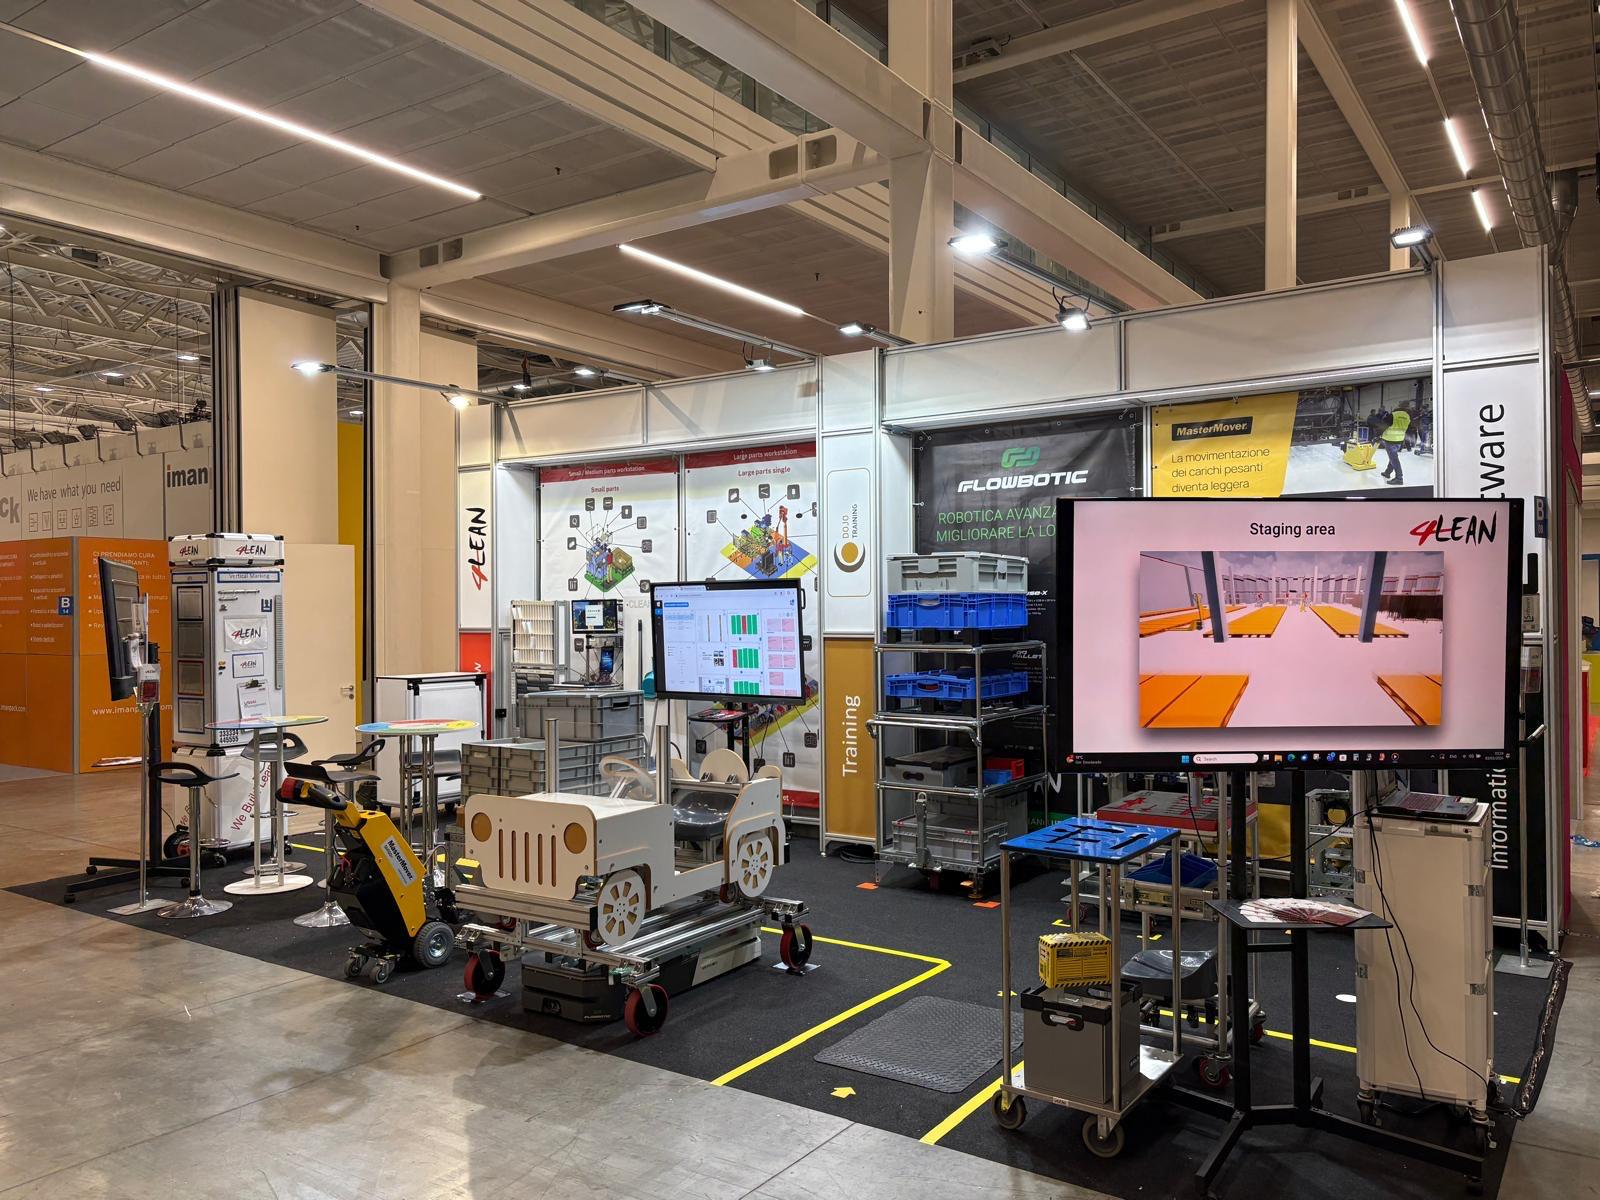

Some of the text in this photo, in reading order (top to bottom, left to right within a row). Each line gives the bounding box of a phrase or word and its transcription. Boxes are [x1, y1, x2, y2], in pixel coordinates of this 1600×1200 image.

[733, 448, 798, 461] Large parts workstation
[1171, 448, 1270, 464] La movimentazione
[166, 464, 213, 490] iman
[604, 467, 616, 475] parts
[738, 466, 791, 478] Large parts single
[1171, 462, 1263, 478] dei carichi pesanti
[27, 476, 121, 502] We have what you need
[606, 485, 620, 493] parts
[957, 470, 1089, 493] FLOWBOTIC
[1171, 480, 1250, 493] diventa leggera
[938, 509, 1003, 525] ROBOTICA
[1536, 502, 1544, 521] B
[842, 515, 850, 539] DOJO
[936, 526, 1015, 542] MIGLIORARE
[1018, 525, 1034, 538] LA
[1250, 522, 1336, 538] Staging area
[1409, 511, 1497, 547] 4LEAN
[179, 544, 199, 557] 4LEAN
[236, 544, 267, 557] 4LEAN
[465, 507, 489, 591] 4LEAN
[61, 597, 71, 608] B
[231, 626, 262, 640] 4LEAN
[842, 695, 861, 777] Training
[230, 814, 247, 831] We
[1486, 768, 1508, 869] Informati
